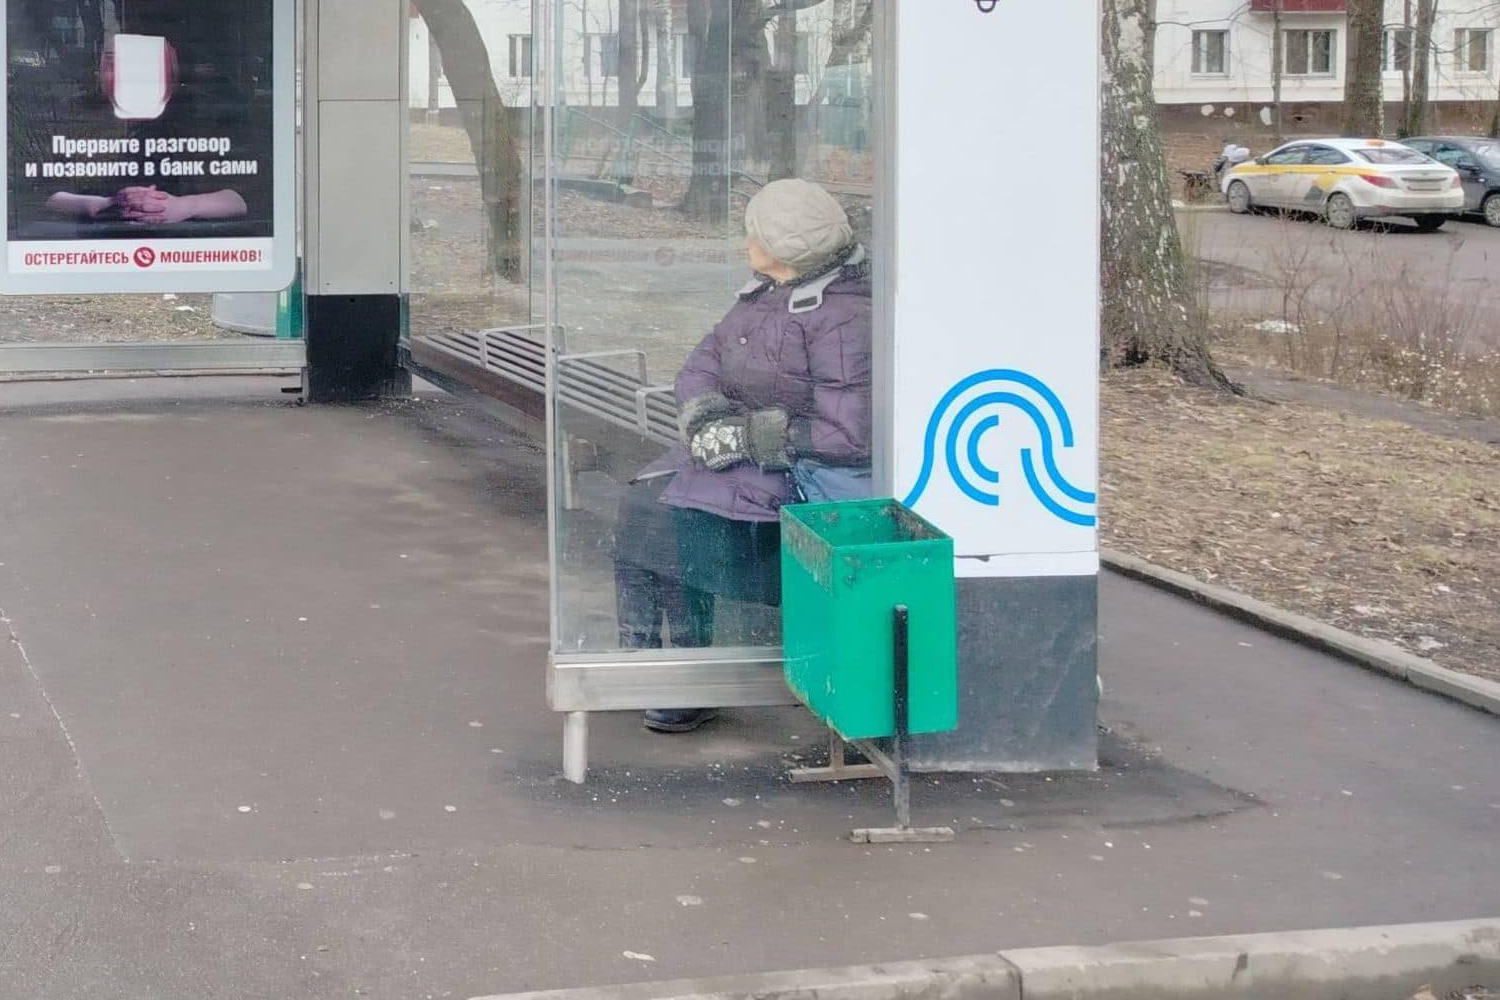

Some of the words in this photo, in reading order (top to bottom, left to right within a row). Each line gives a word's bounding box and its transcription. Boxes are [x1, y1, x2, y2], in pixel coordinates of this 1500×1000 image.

[52, 135, 140, 157] Прервите
[145, 136, 231, 157] разговор
[25, 163, 37, 178] и
[42, 161, 138, 178] позвоните
[144, 162, 155, 176] в
[160, 157, 204, 176] банк
[209, 160, 258, 176] сами
[25, 251, 129, 266] ОСТЕРЕГАЙТЕСЬ
[160, 250, 262, 264] МОШЕННИКОВ!
